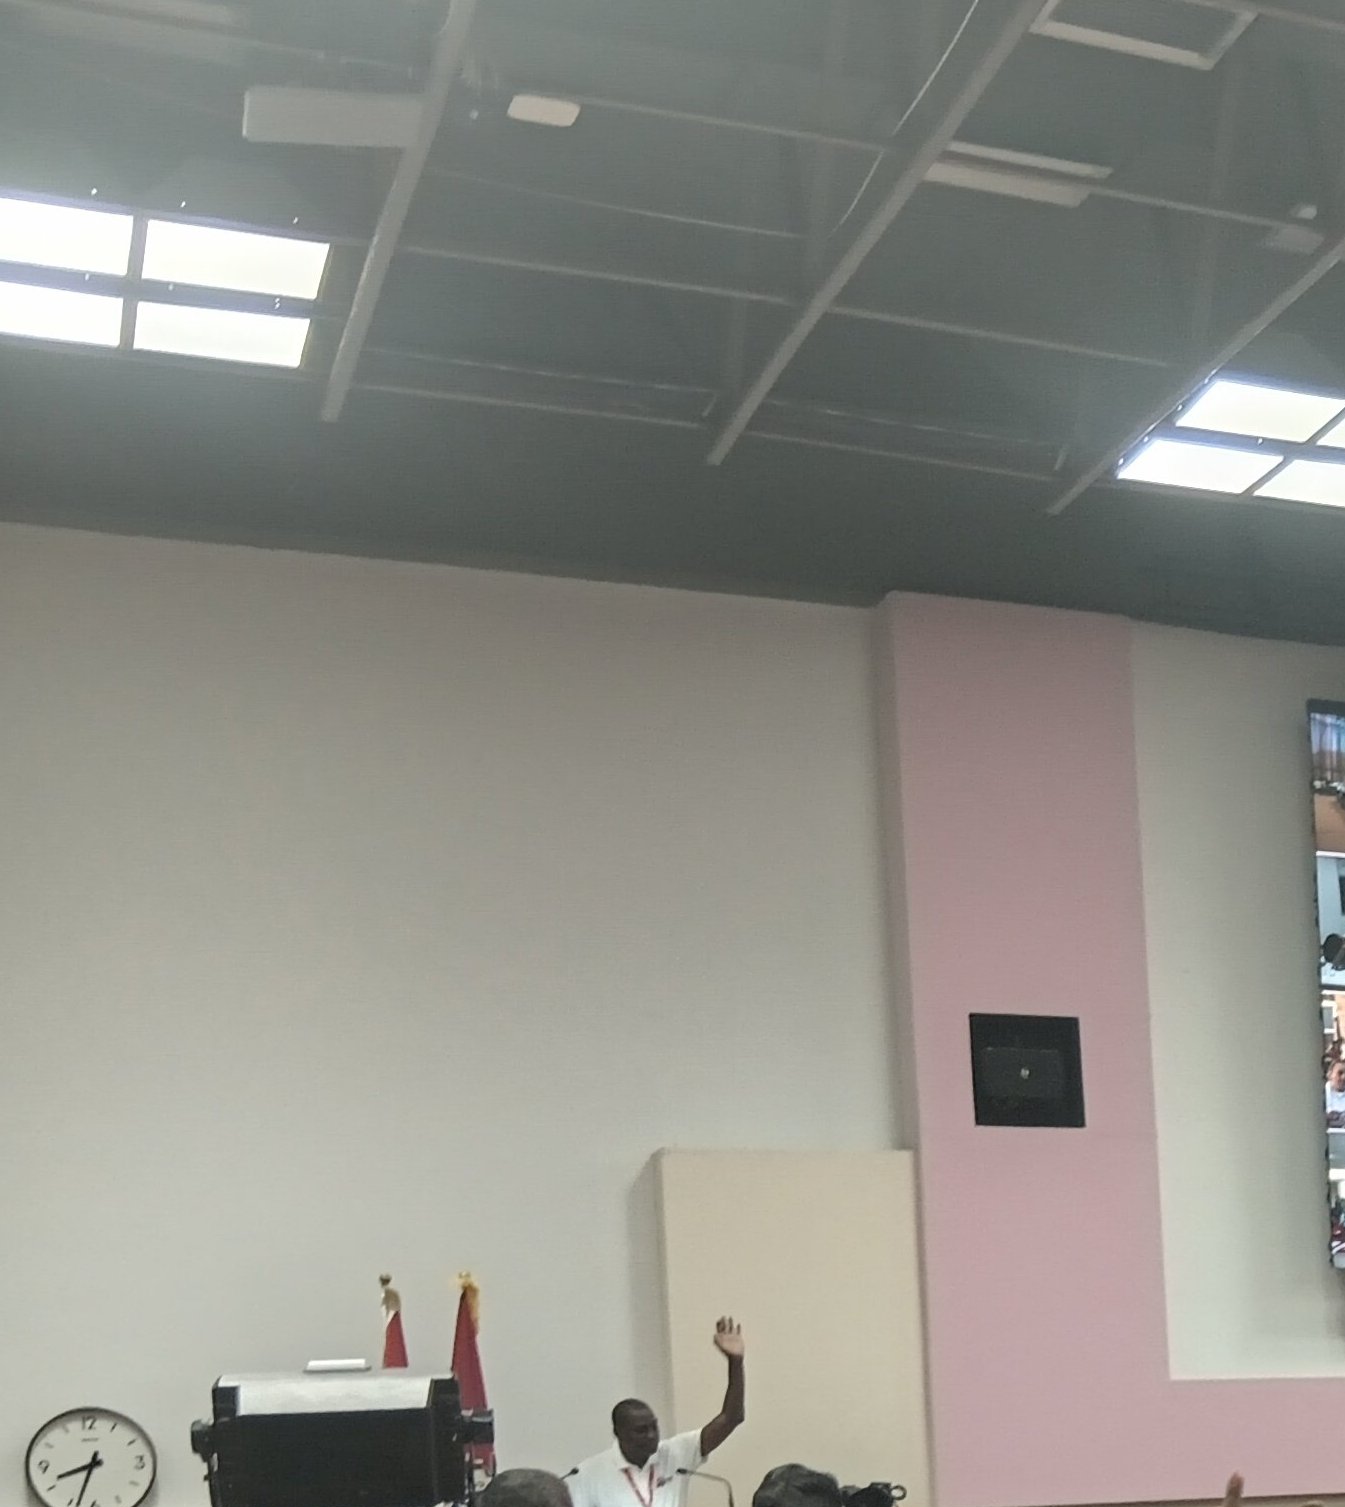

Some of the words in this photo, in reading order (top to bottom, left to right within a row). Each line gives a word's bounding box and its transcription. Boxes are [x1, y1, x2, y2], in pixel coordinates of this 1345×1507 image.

[82, 1416, 97, 1430] 12
[38, 1459, 50, 1474] 9
[134, 1455, 146, 1470] 3
